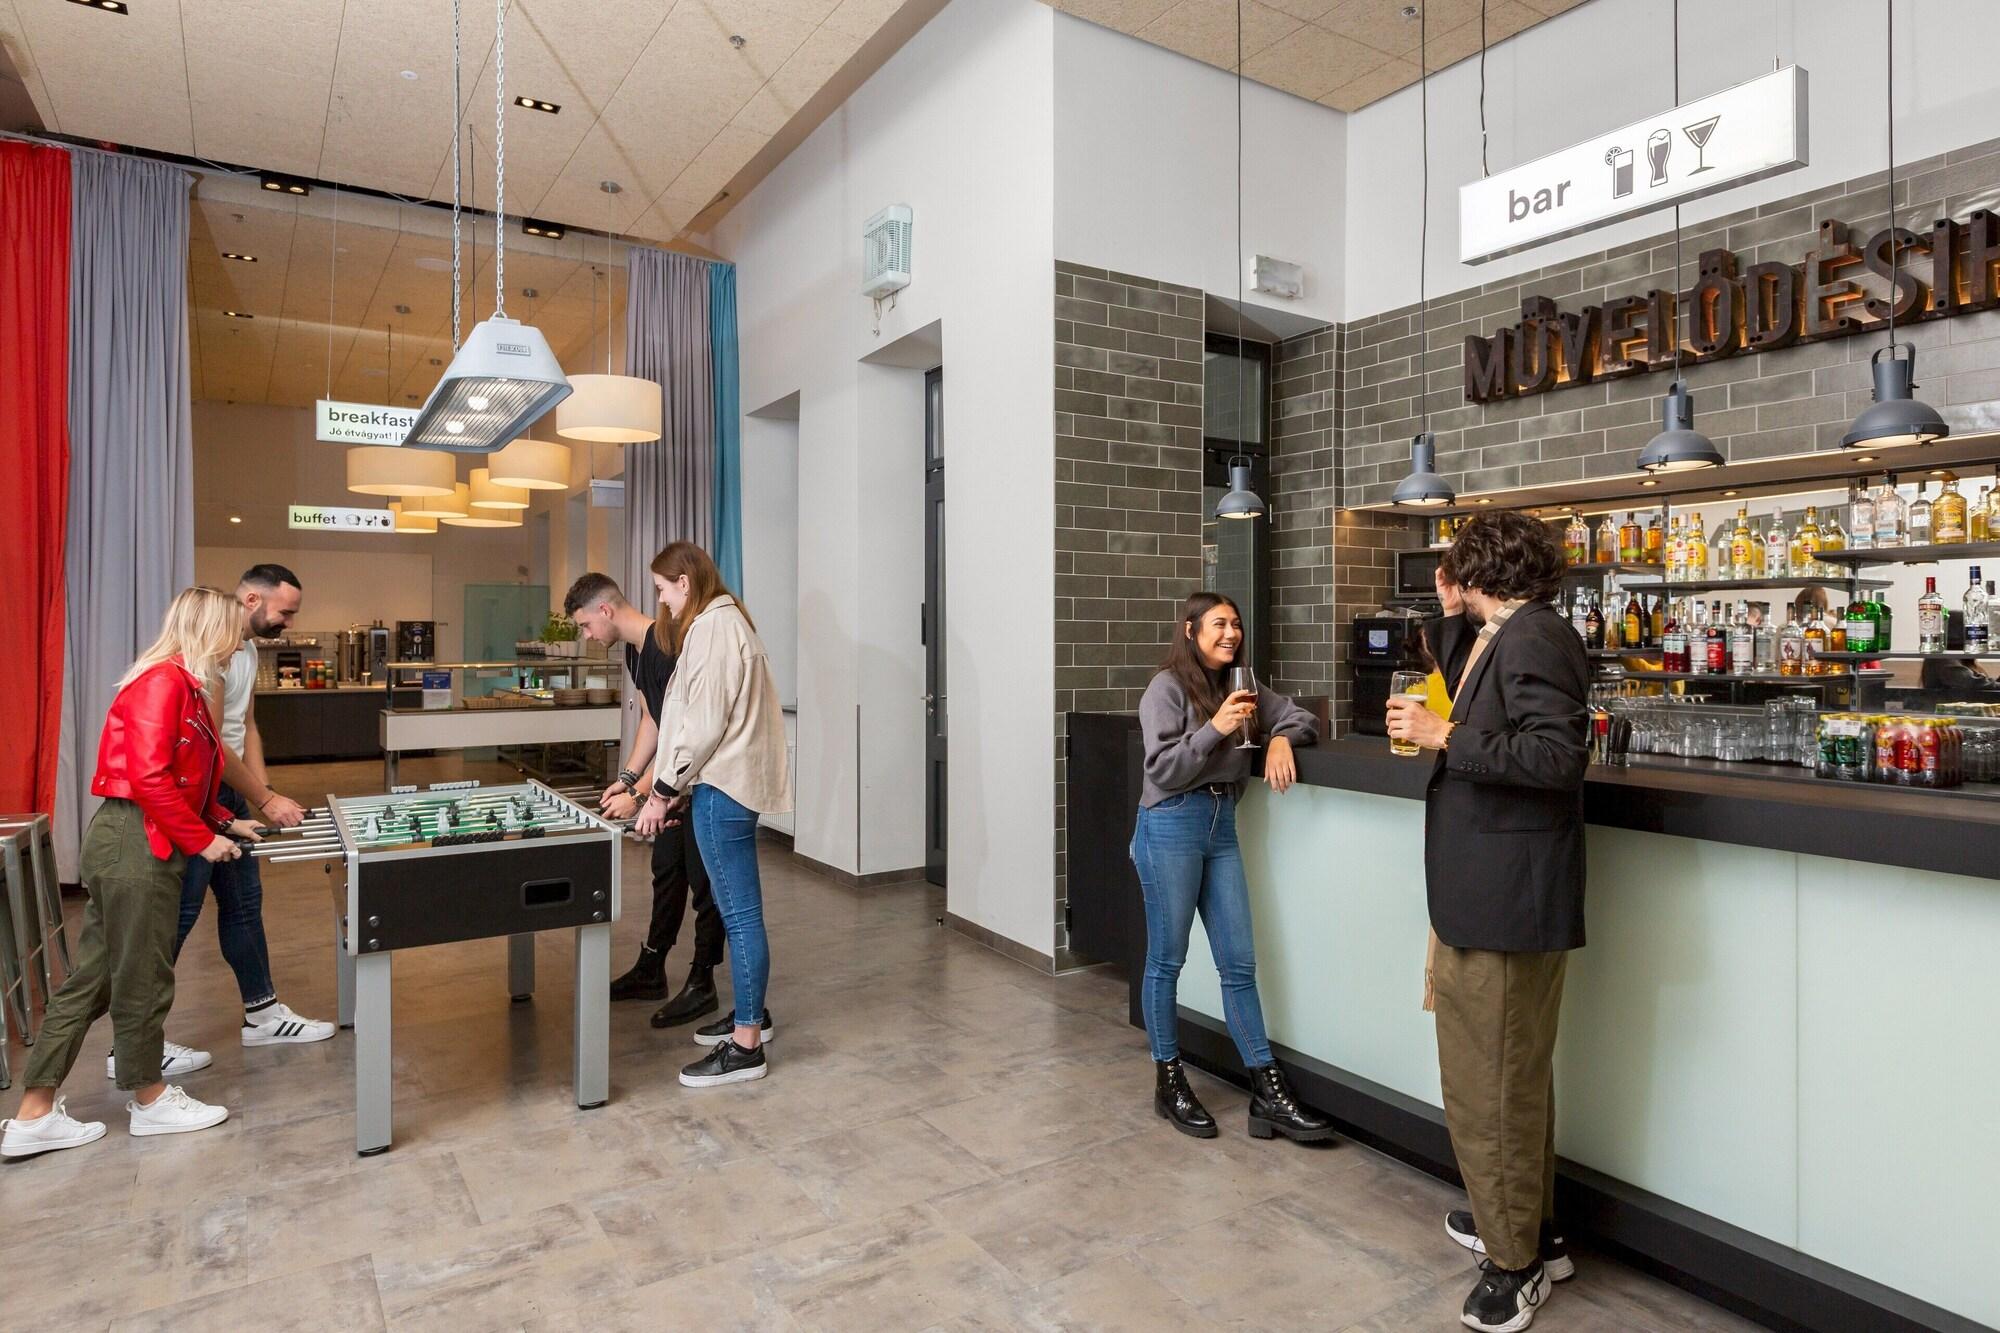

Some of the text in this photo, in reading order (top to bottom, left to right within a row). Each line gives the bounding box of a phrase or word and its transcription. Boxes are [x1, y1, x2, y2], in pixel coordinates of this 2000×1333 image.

[1508, 180, 1571, 223] bar
[328, 407, 415, 428] breakfast
[329, 427, 342, 436] Jó
[344, 428, 392, 440] étvágyat!
[293, 512, 337, 525] buffet
